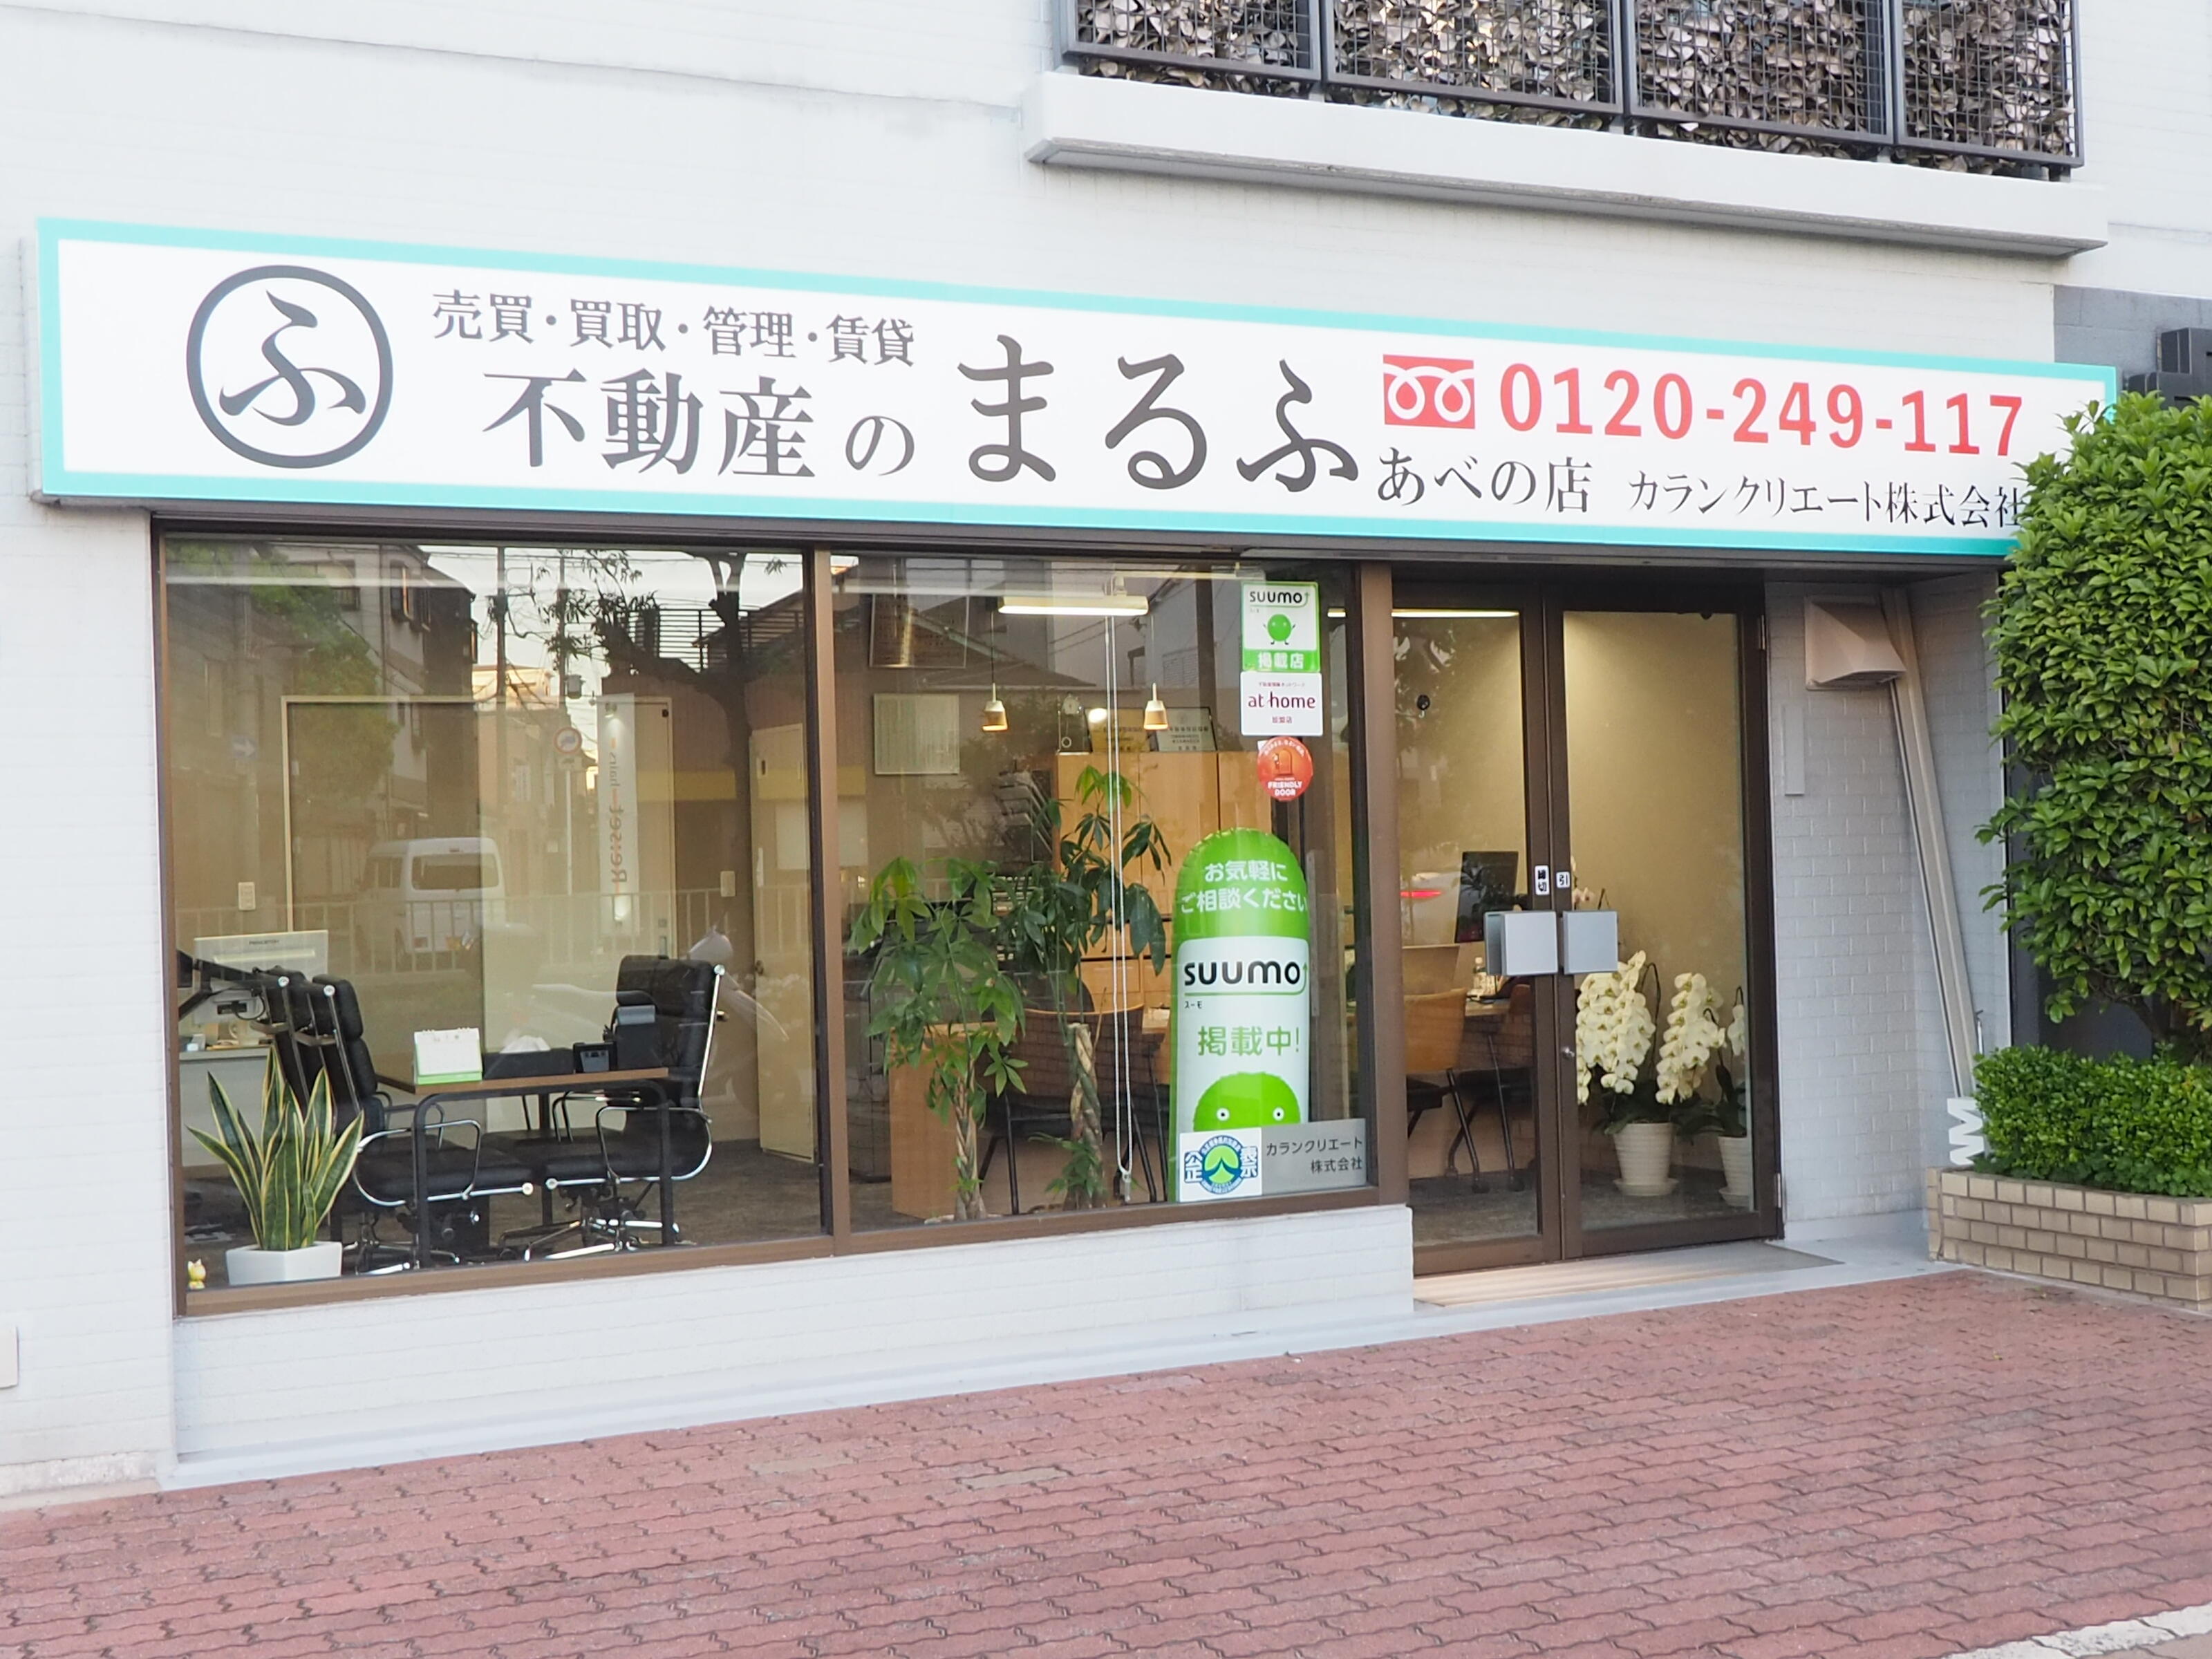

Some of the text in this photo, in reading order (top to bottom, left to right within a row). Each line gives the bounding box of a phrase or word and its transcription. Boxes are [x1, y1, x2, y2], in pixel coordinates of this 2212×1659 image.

[432, 289, 915, 367] 売買・買取・管理・賃貸
[219, 290, 366, 426] ふ
[482, 334, 1359, 493] 不動産の まるふ
[1499, 364, 2023, 456] 0120-249-117
[1378, 447, 2026, 528] あべの店 カランクリエート株式会社
[1248, 691, 1315, 709] at home
[1204, 860, 1288, 882] お気軽に
[1181, 888, 1308, 914] ご相談ください
[1184, 1001, 1203, 1009] スーモ
[1266, 1136, 1362, 1156] カランクリエート
[1185, 1152, 1203, 1181] 公正
[1311, 1156, 1362, 1174] 株式会社
